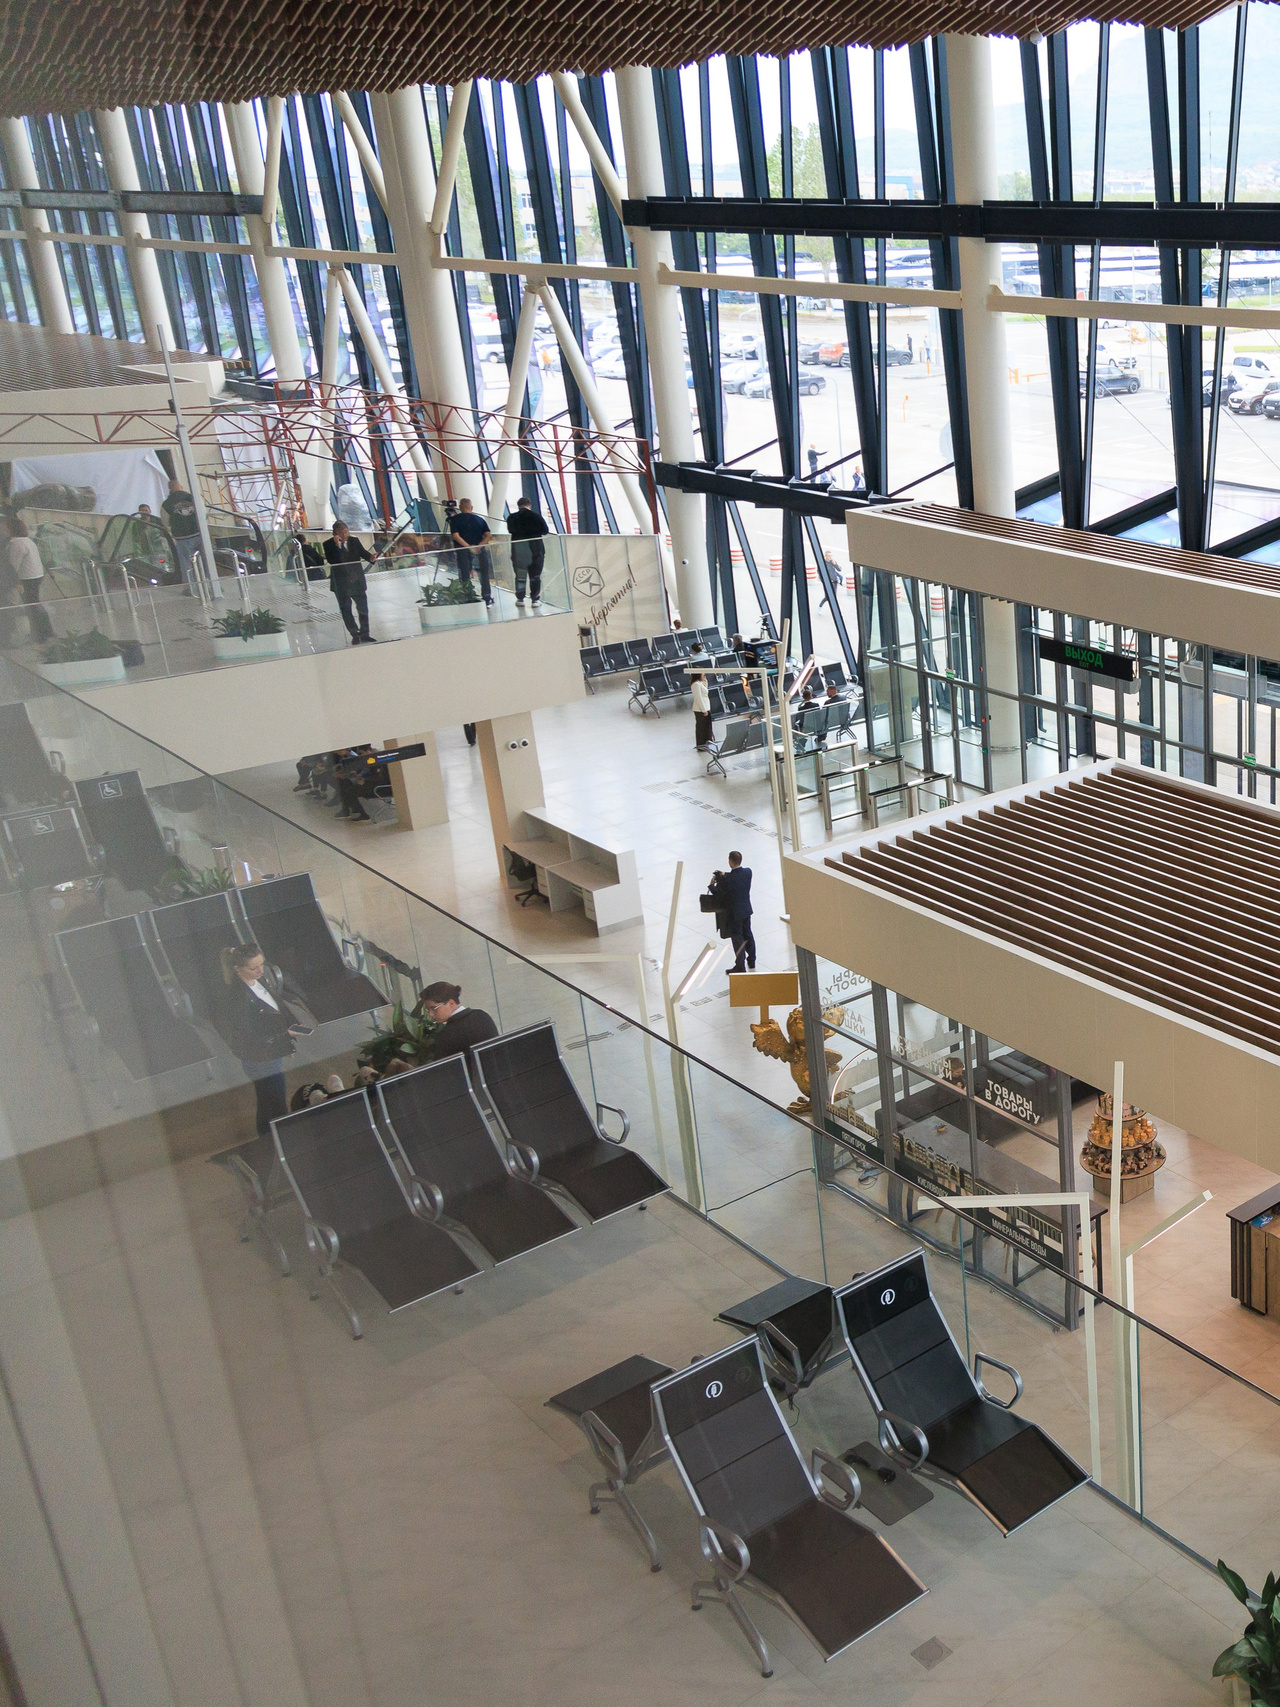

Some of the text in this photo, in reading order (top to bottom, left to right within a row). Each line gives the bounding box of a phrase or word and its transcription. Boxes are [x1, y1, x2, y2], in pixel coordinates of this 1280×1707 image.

[576, 569, 591, 583] СССР
[584, 564, 637, 626] вероятно!
[1065, 644, 1104, 669] ВЫХОД
[985, 1088, 1040, 1125] В ДОРОГУ
[987, 1079, 1033, 1112] ТОВАРЫ
[1030, 1240, 1047, 1257] ВОДЫ
